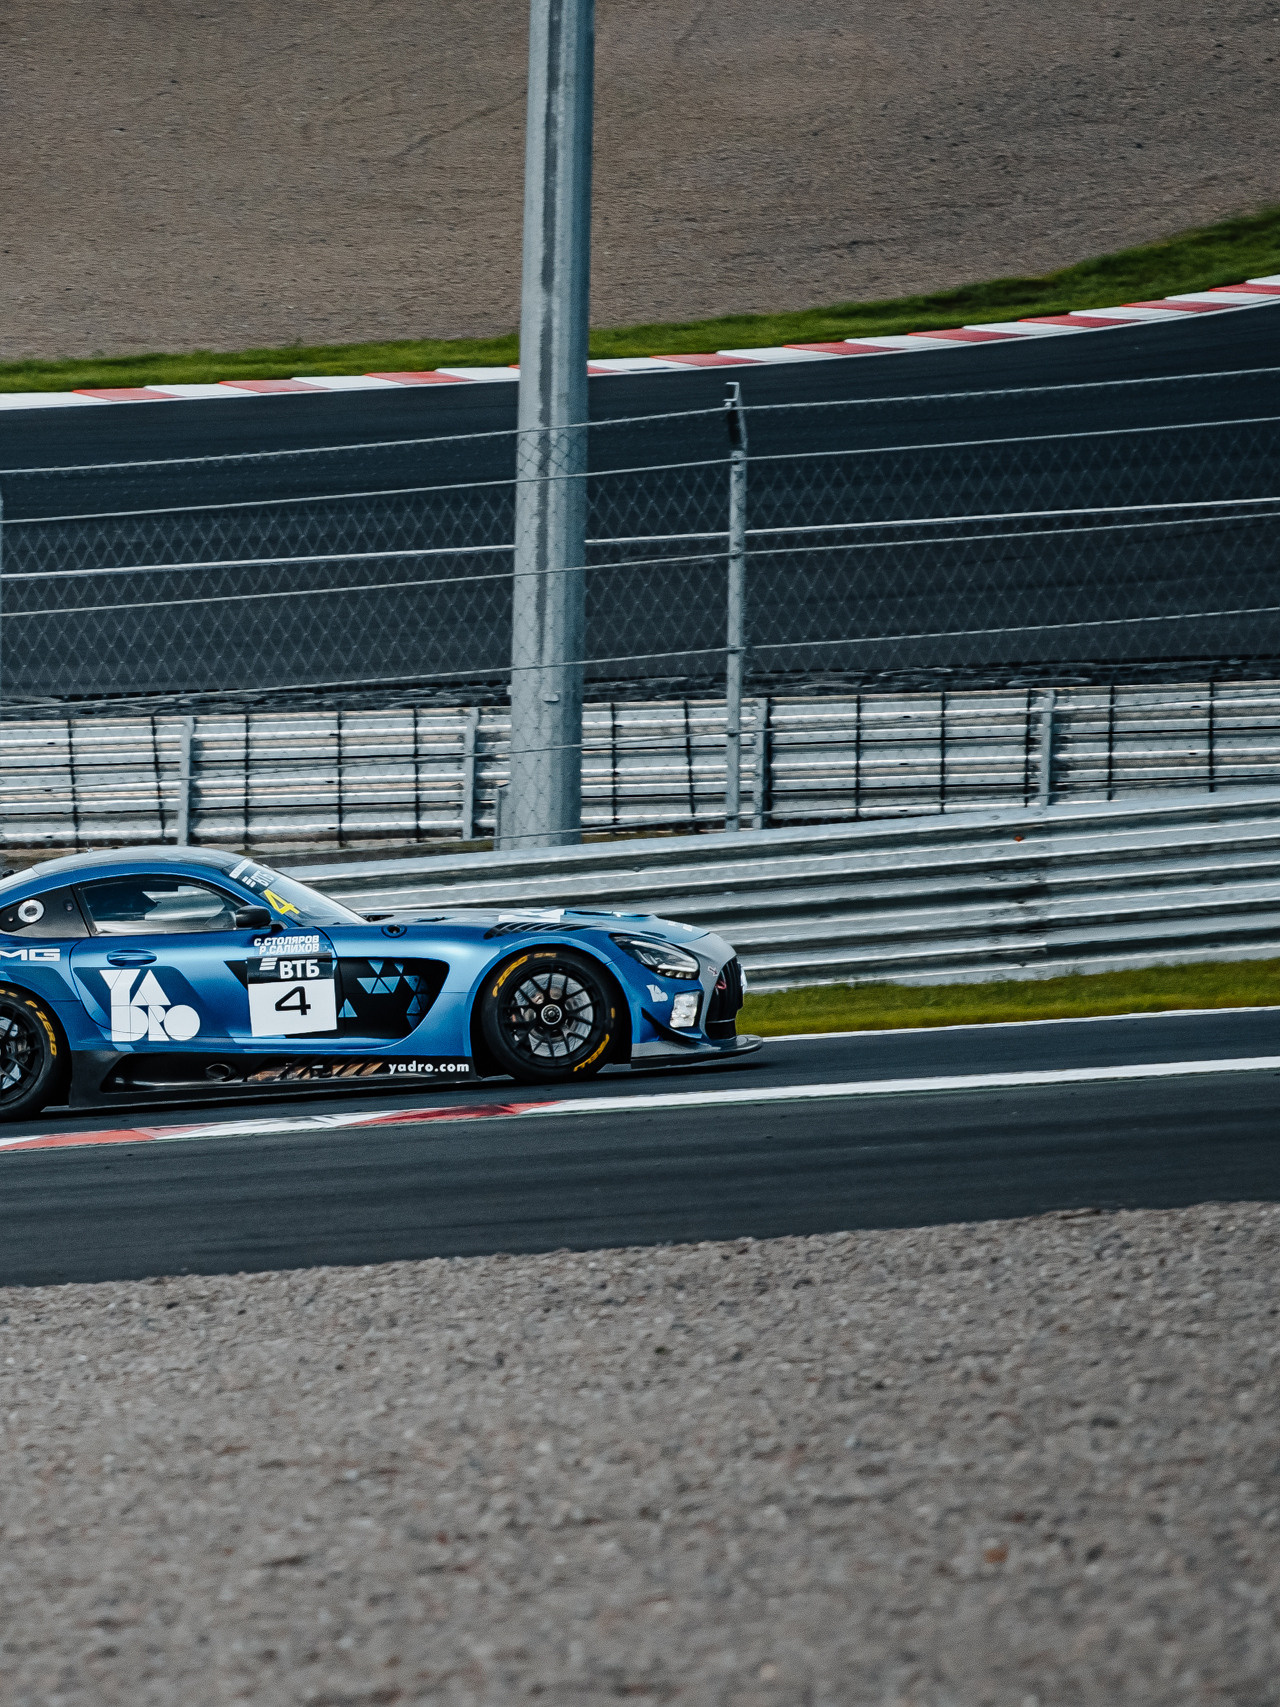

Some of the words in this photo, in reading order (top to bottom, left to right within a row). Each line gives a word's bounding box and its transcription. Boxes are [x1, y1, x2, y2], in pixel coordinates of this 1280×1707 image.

[263, 888, 300, 915] 4
[253, 935, 320, 947] С.СТОЛЯРОВ
[259, 943, 320, 955] Р.САЛИХОВ
[279, 959, 320, 980] ВТБ
[274, 985, 312, 1016] 4
[388, 1060, 470, 1075] yadro.com
